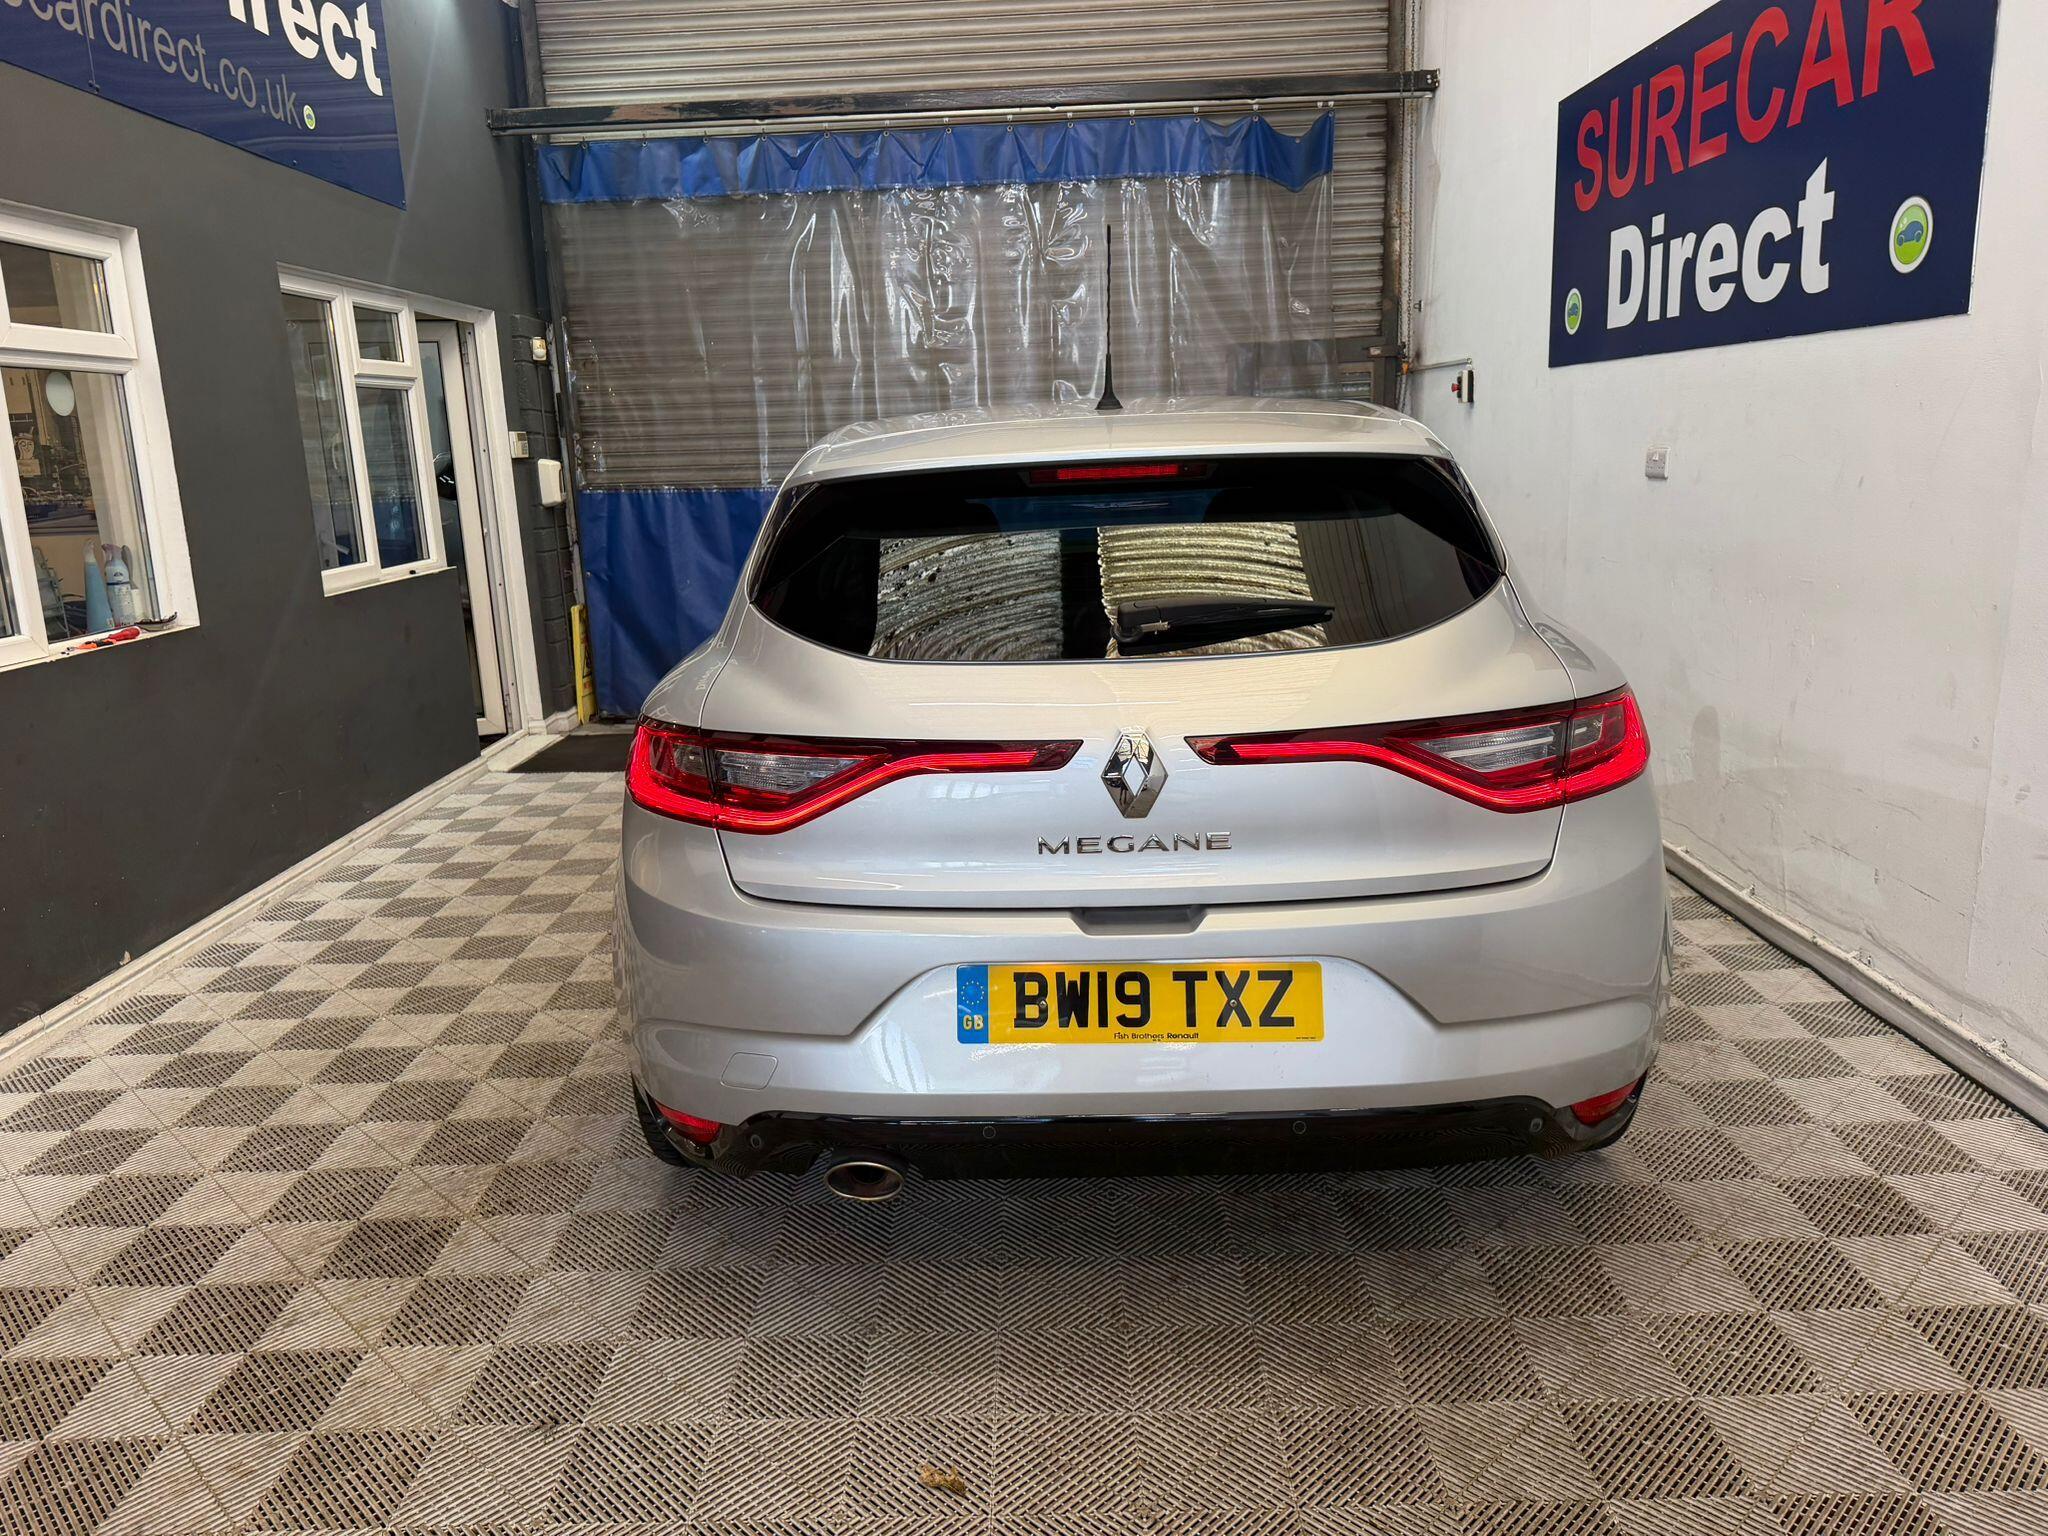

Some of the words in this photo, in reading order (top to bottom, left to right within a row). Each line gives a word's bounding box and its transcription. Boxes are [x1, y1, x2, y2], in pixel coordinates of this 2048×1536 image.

[3, 0, 302, 129] cardirect.co.uk
[229, 0, 383, 96] ect
[1574, 0, 1935, 211] SURECAR
[1606, 157, 1835, 329] Direct
[1038, 831, 1232, 855] MEGANE
[963, 1014, 984, 1030] GB
[1013, 970, 1150, 1028] BW19
[1173, 970, 1295, 1027] TXZ
